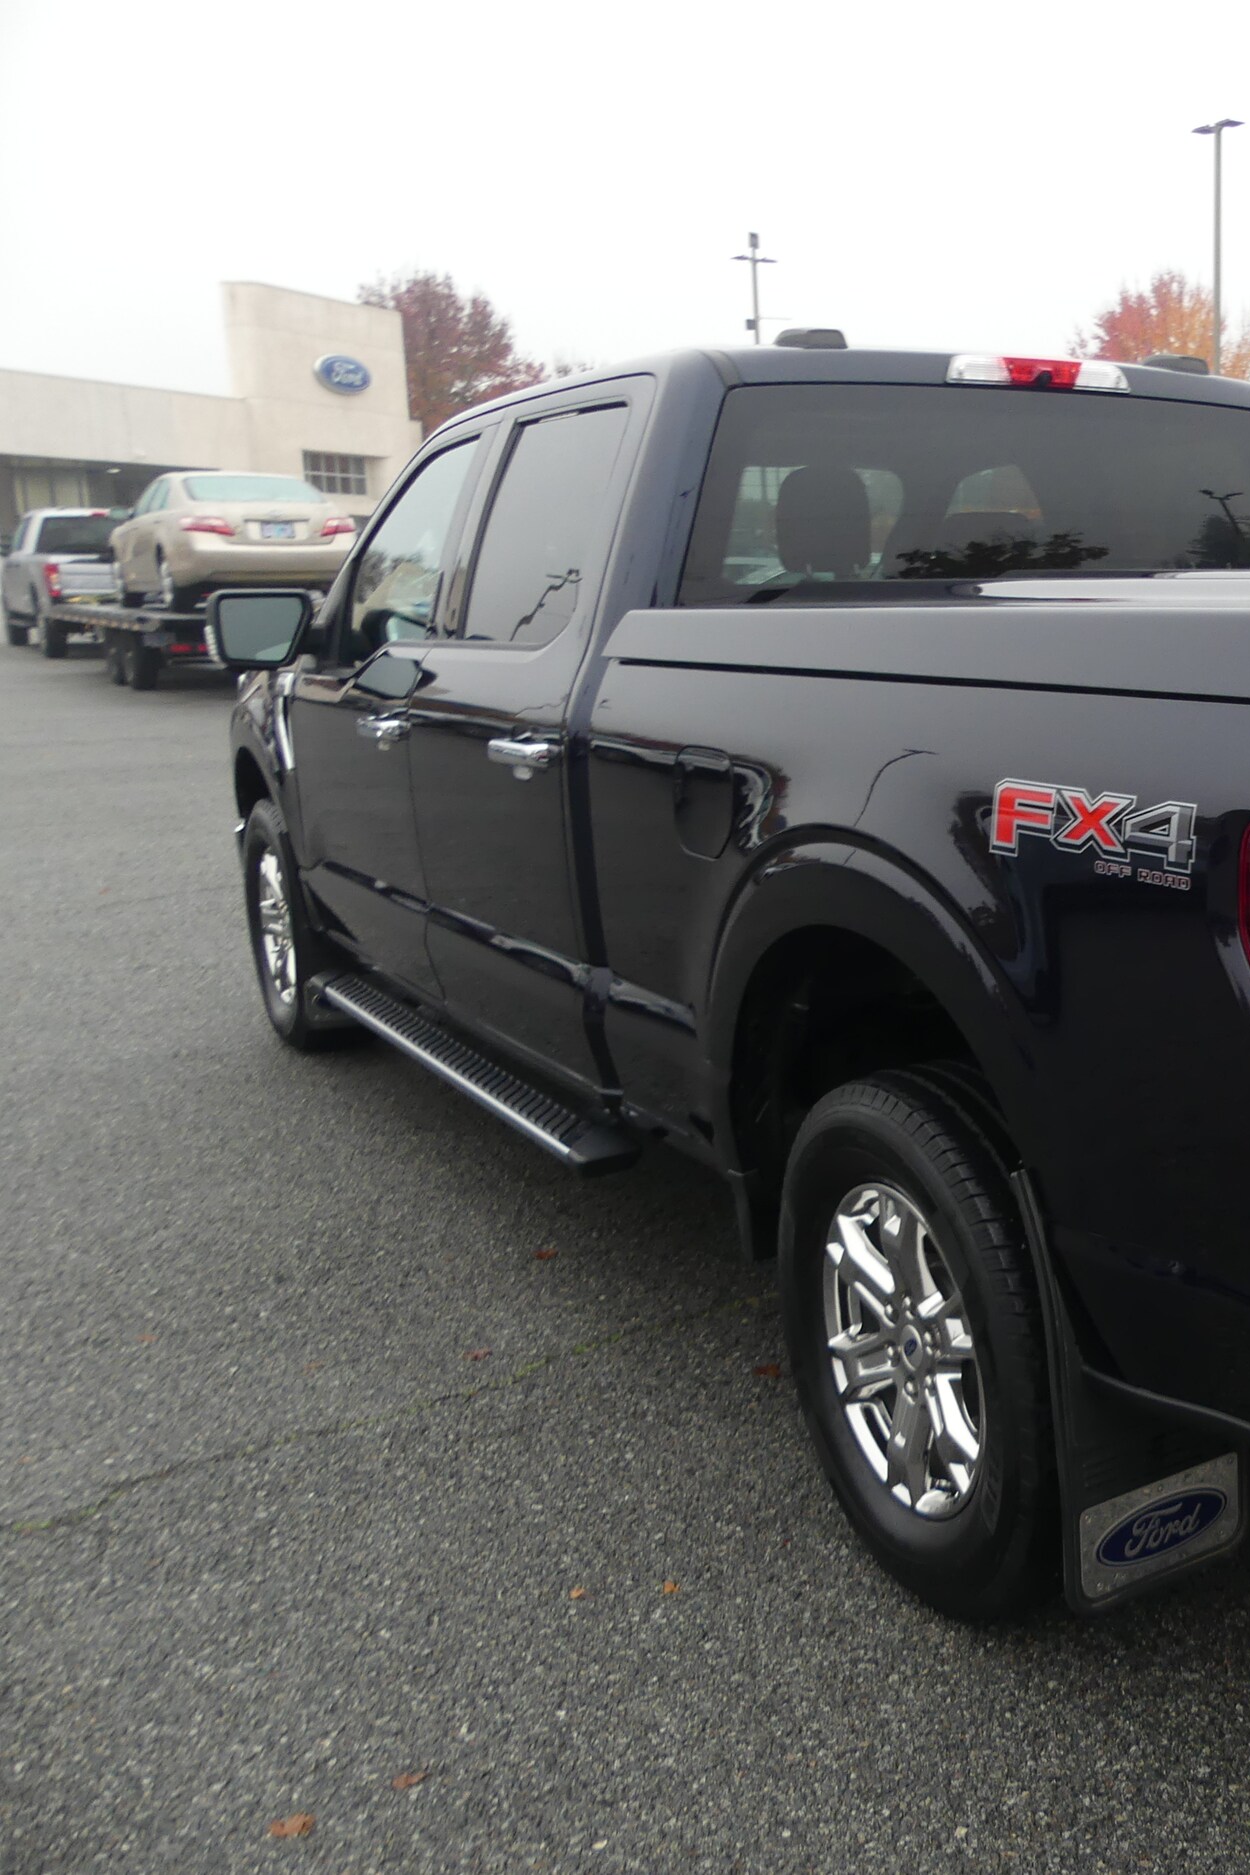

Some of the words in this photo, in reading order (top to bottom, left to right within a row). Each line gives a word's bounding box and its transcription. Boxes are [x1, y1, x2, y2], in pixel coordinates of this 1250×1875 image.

[989, 778, 1198, 873] FX4
[1094, 860, 1132, 877] OFF
[1137, 868, 1191, 891] ROAD
[1124, 1501, 1202, 1557] Ford
